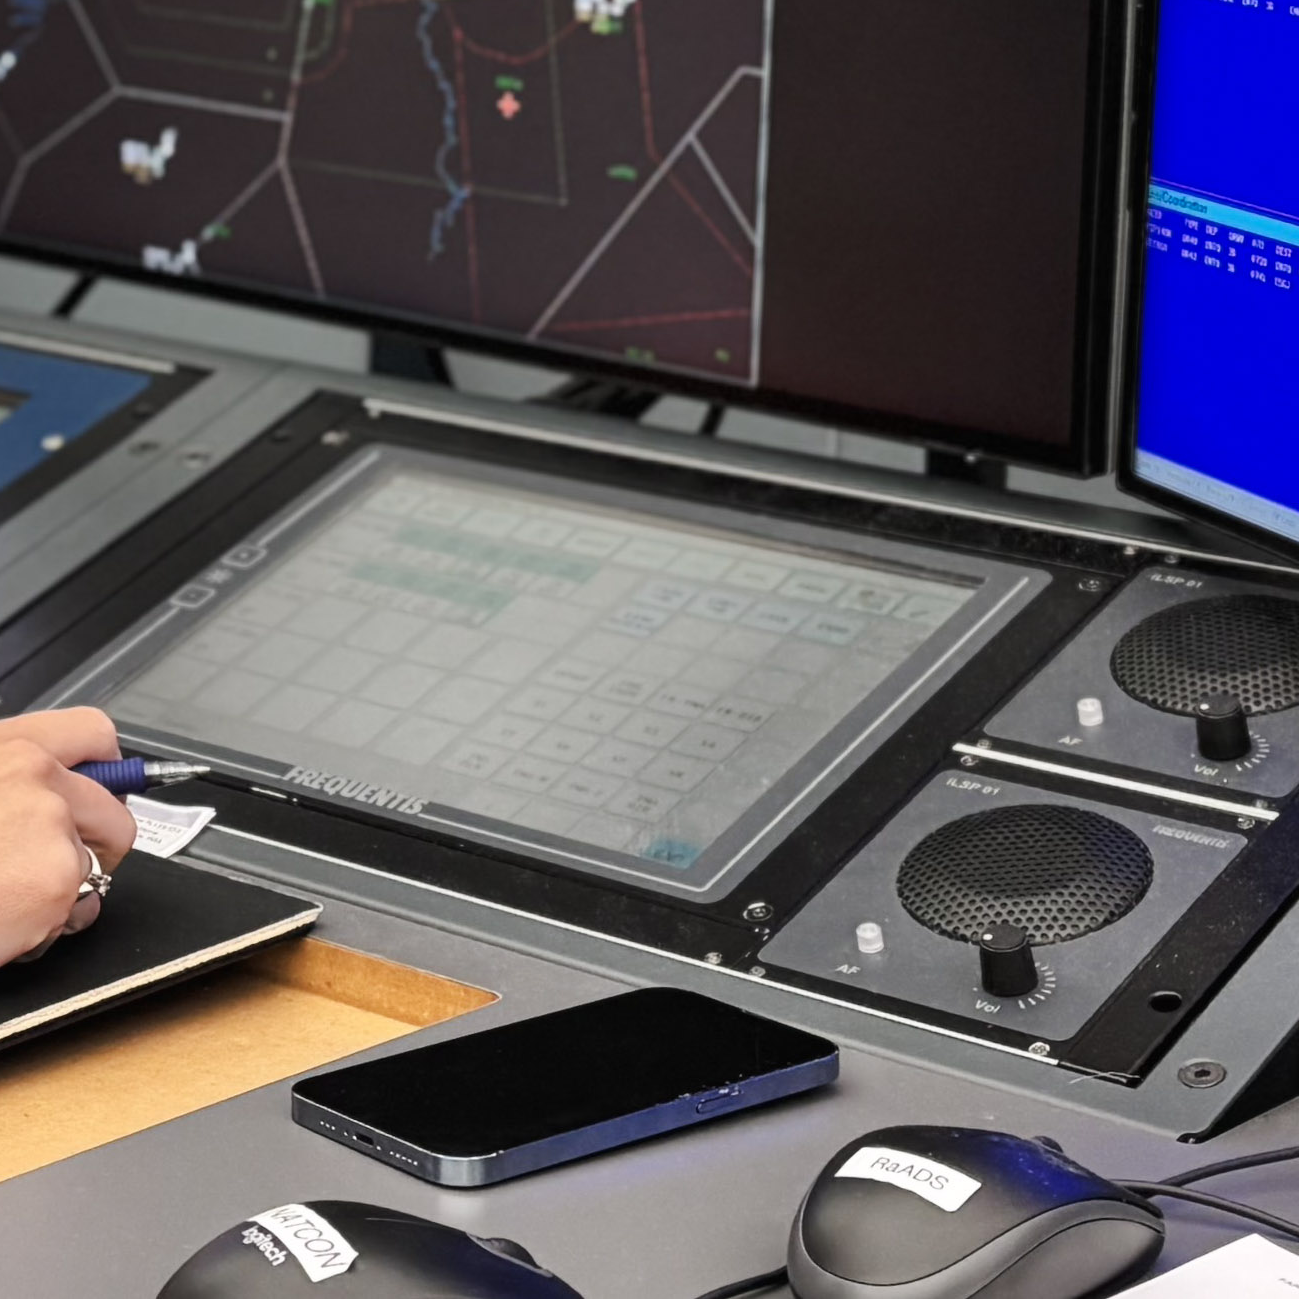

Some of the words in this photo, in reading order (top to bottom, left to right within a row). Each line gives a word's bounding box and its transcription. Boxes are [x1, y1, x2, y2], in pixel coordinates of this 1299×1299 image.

[1057, 735, 1084, 746] AF
[1194, 763, 1219, 777] Vol
[282, 765, 429, 815] FREQUENTIS
[945, 777, 982, 790] ILSP
[982, 785, 1001, 796] 01
[835, 964, 862, 975] AF
[974, 999, 1002, 1014] Vol
[870, 1156, 950, 1191] RaADS
[241, 1225, 289, 1267] logitech
[271, 1207, 348, 1269] NATCON
